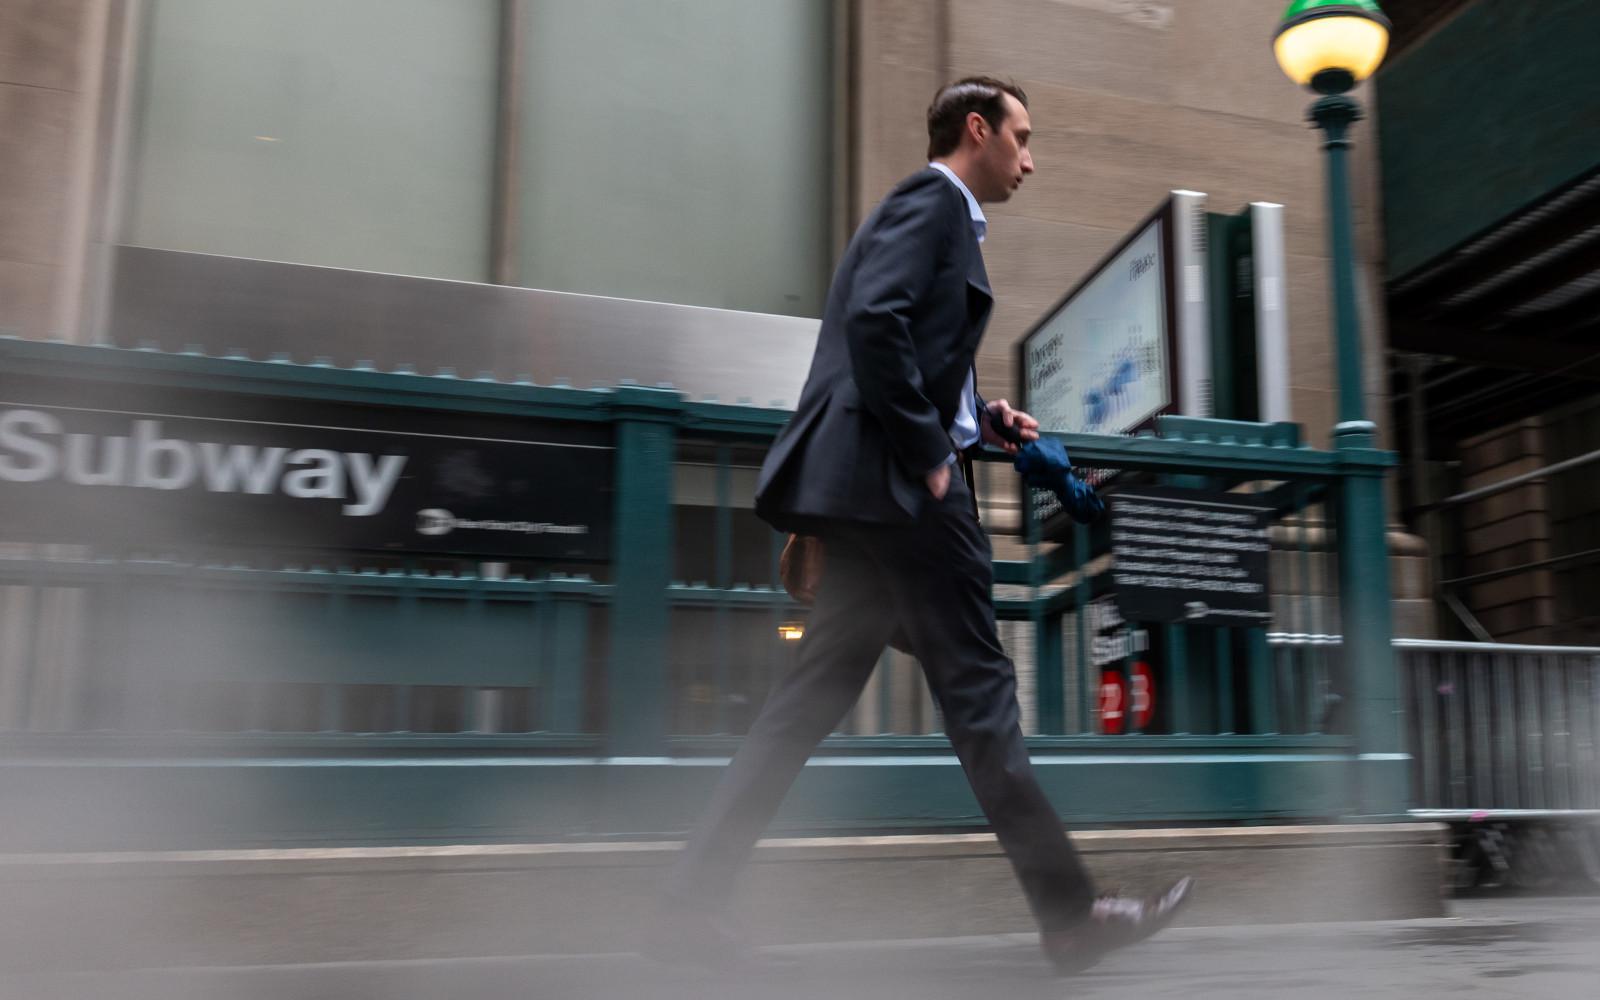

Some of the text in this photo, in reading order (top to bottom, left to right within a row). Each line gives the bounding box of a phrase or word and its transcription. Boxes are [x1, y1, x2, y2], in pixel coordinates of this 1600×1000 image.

[0, 409, 408, 517] Subway
[1099, 674, 1151, 719] 2 3
